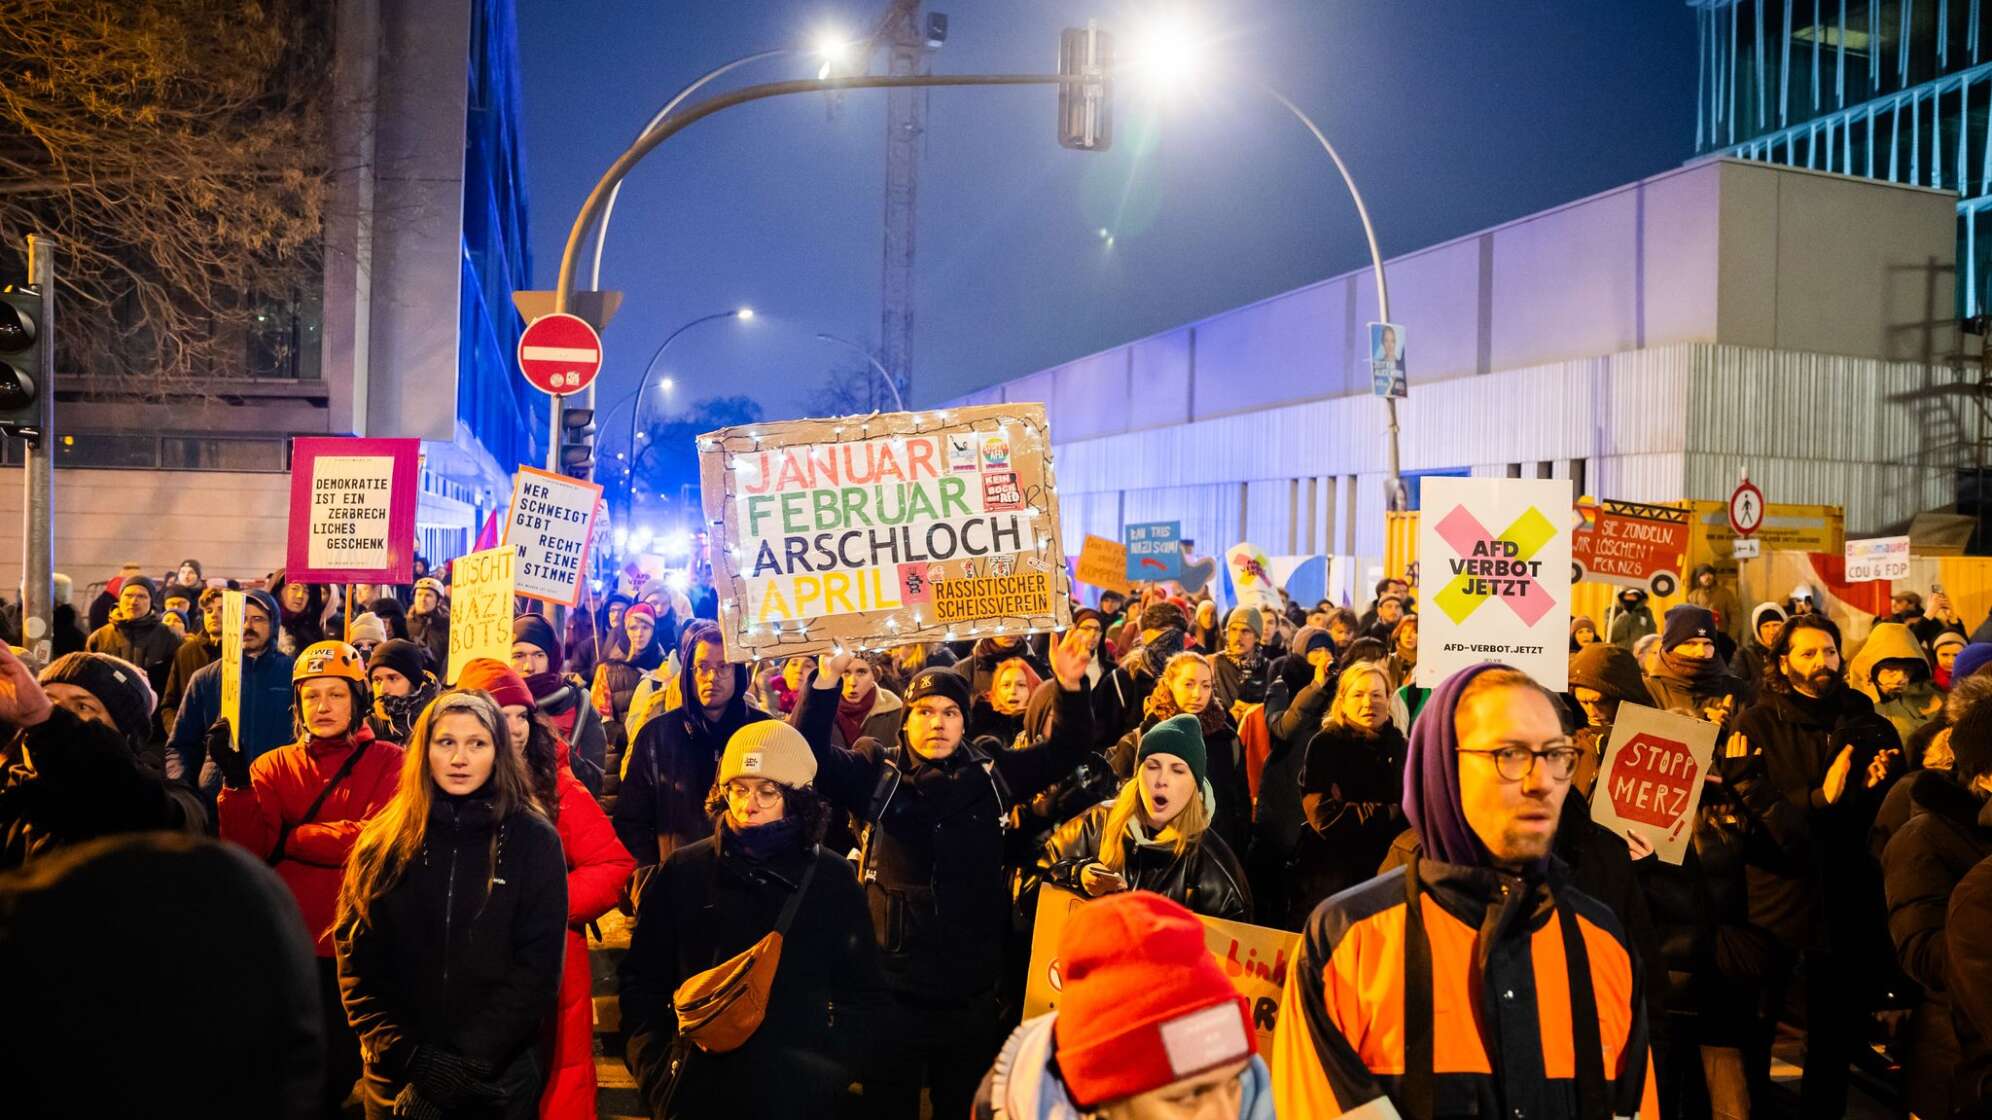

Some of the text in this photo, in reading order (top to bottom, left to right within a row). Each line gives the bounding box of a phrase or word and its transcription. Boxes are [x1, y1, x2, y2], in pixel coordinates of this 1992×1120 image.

[745, 438, 940, 494] JANUAR
[316, 478, 388, 490] DEMOKRATIE
[523, 483, 549, 499] WER
[315, 493, 365, 504] IST EIN
[748, 476, 974, 537] FEBRUAR
[328, 508, 386, 519] ZERBRECH
[520, 498, 588, 525] SCHWEIGT
[313, 523, 356, 534] LICHES
[516, 513, 551, 531] GIBT
[326, 538, 385, 549] GESCHENK
[539, 534, 582, 554] RECHT
[751, 514, 1022, 578] ARSCHLOCH
[1472, 540, 1519, 558] AFD
[516, 543, 579, 570] N EINE
[524, 563, 576, 584] STIMME
[1449, 558, 1542, 578] VERBOT
[1848, 566, 1871, 578] CDU
[1885, 562, 1908, 576] FDP
[757, 567, 904, 624] APRIL
[936, 574, 1047, 600] RASSISTISCHER
[1462, 578, 1530, 597] JETZT
[451, 592, 508, 625] NAZI
[937, 593, 1048, 619] SCHEISSVEREIN
[451, 617, 509, 654] BOTS
[1443, 643, 1544, 655] AFD-VERBOT.JETZT
[1624, 742, 1695, 780] STOPP
[1614, 775, 1688, 816] MERZ
